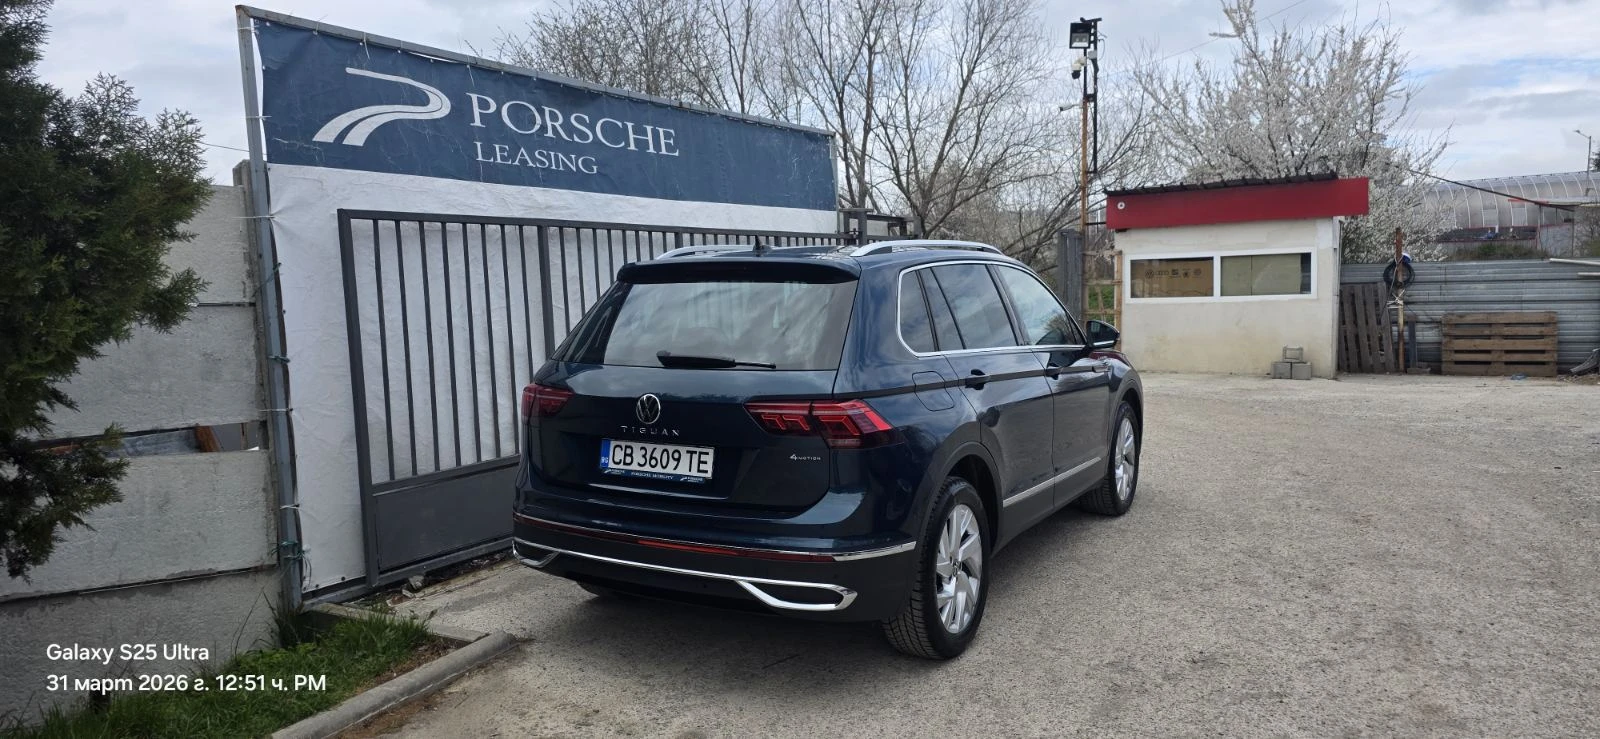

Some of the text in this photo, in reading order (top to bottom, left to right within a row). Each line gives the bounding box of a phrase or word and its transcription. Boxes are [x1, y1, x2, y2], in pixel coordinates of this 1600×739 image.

[466, 92, 680, 156] PORSCHE
[474, 141, 599, 175] LEASING
[620, 425, 680, 436] TIGUAN
[612, 444, 710, 473] CB 3609 TE
